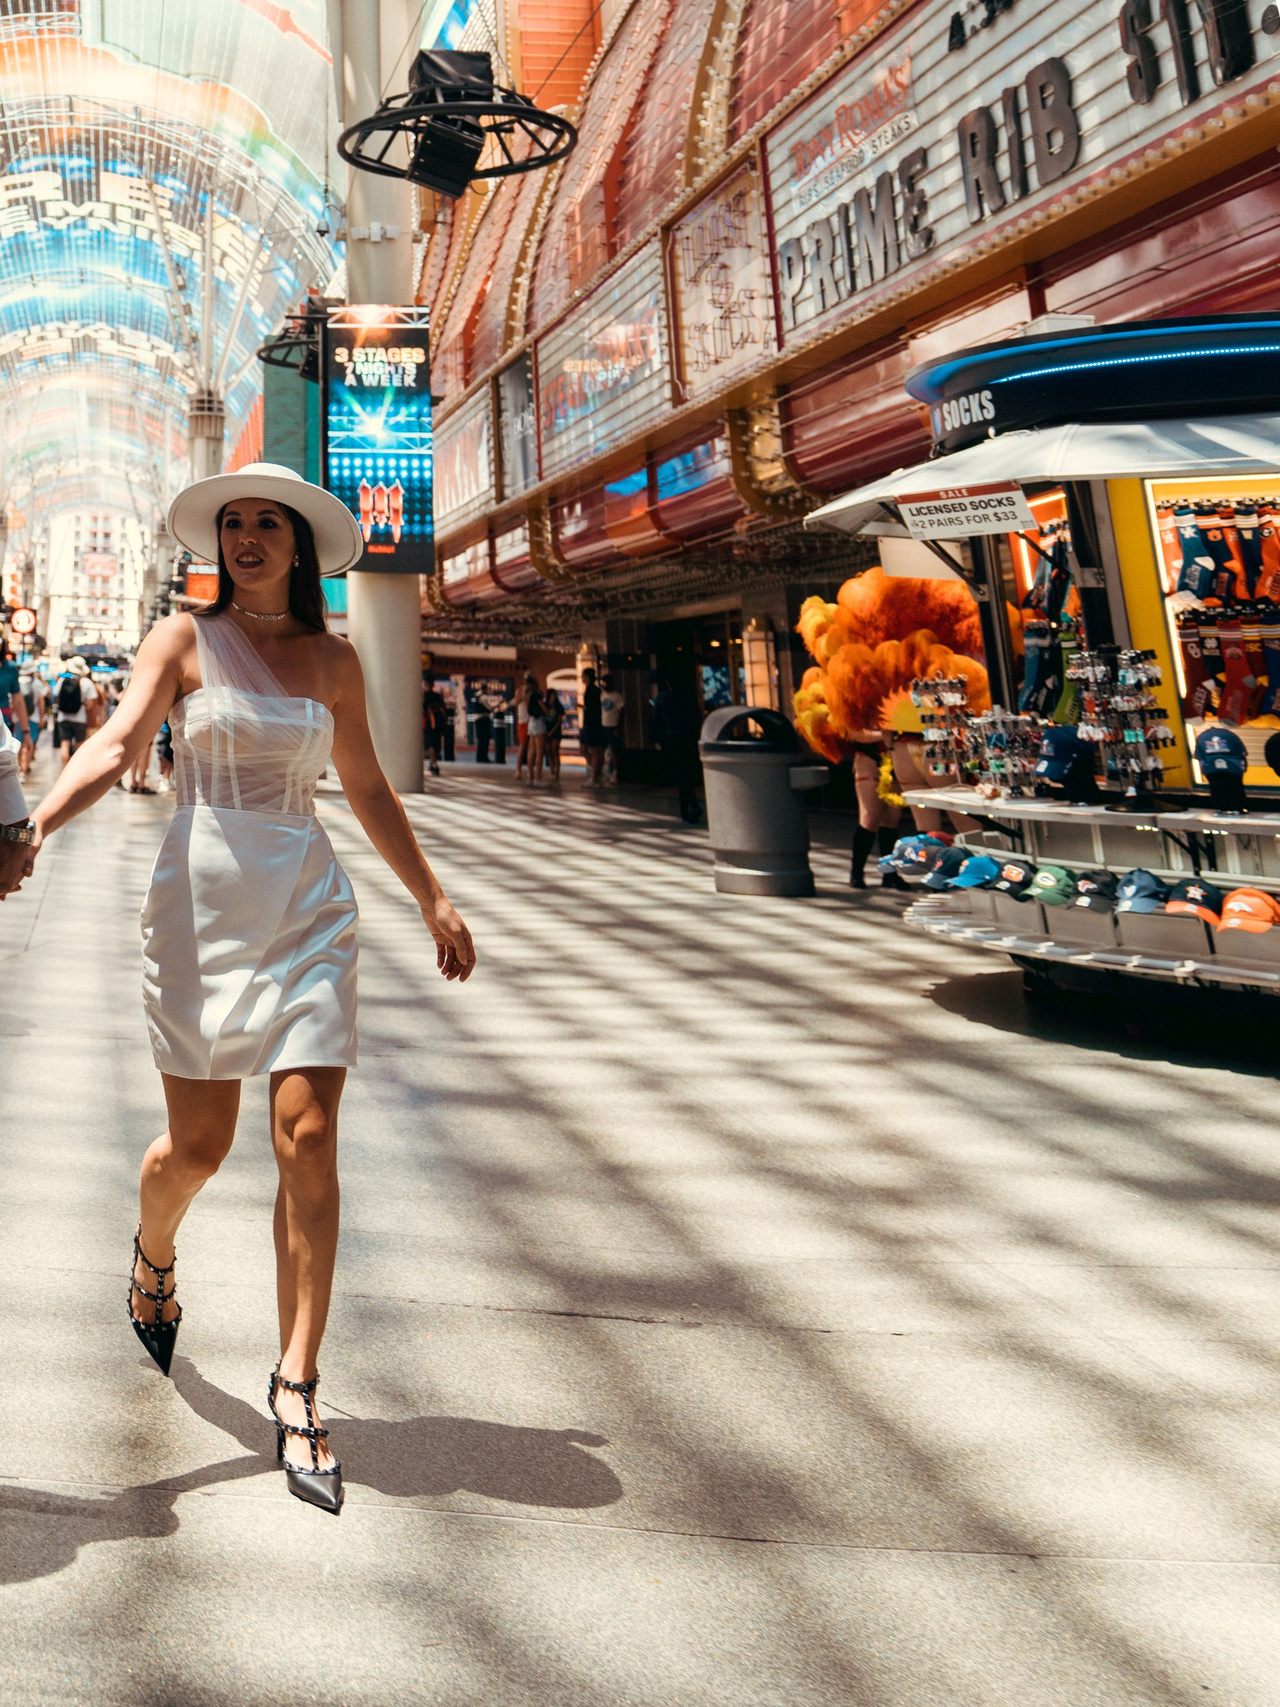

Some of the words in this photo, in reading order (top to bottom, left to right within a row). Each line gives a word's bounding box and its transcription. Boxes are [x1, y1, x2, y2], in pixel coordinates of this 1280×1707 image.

[789, 121, 836, 182] TONY
[834, 67, 908, 148] ROMA'S
[824, 149, 866, 189] SEAFOOD
[871, 115, 912, 154] STEAKS
[779, 146, 937, 329] PRIME
[958, 57, 1081, 223] RIB
[334, 347, 349, 363] 3
[352, 347, 426, 364] STAGES
[344, 362, 354, 375] 7
[355, 361, 417, 375] NIGHTS
[344, 374, 357, 387] A
[361, 374, 417, 387] WEEK
[942, 390, 996, 431] SOCKS
[939, 488, 969, 499] SALE
[908, 503, 968, 517] LICENSED
[969, 496, 1016, 511] SOCKS
[928, 516, 964, 529] PAIRS
[966, 513, 992, 525] FOR
[994, 510, 1018, 523] $33
